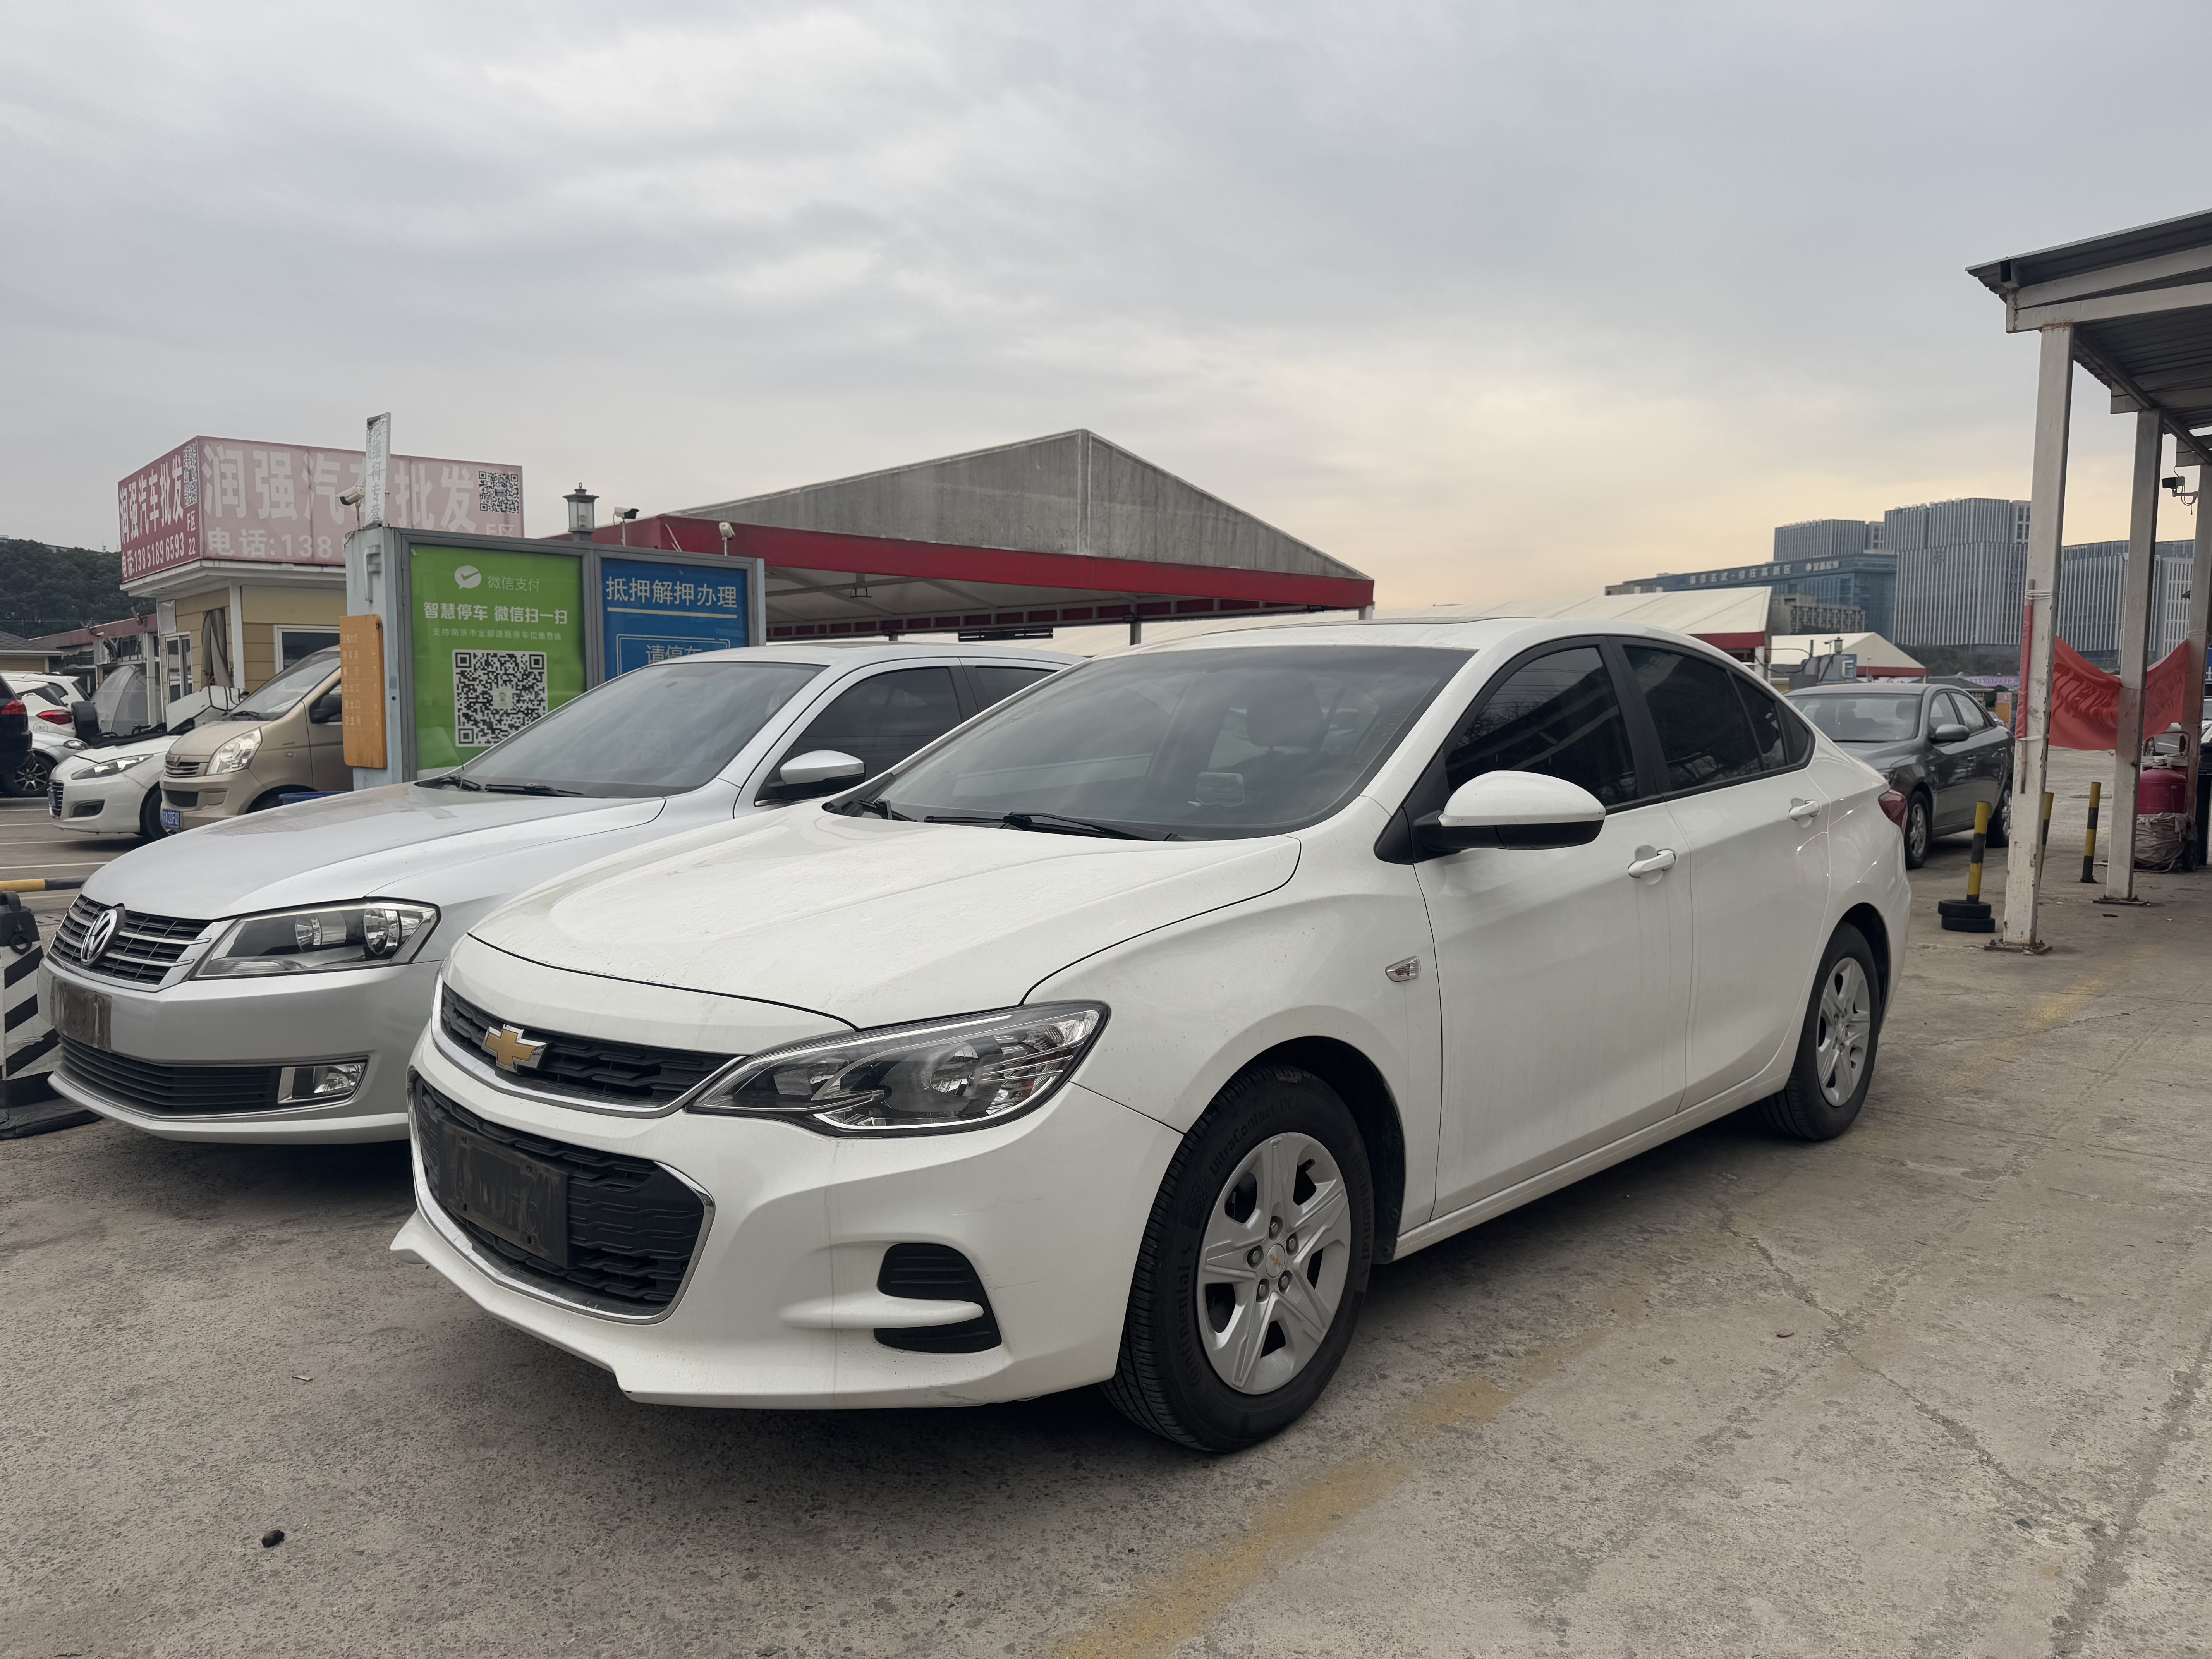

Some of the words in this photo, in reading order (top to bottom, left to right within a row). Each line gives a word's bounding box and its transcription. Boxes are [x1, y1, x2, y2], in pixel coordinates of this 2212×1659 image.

[119, 454, 184, 544] 润强汽车批发
[187, 510, 196, 531] F区
[189, 537, 196, 556] 22
[364, 544, 381, 602] F
[488, 575, 541, 592] 微信支付
[606, 576, 737, 608] 抵押解押办理
[424, 601, 489, 620] 智慧停车
[494, 605, 568, 625] 微信扫一扫
[1842, 659, 1854, 678] E
[1209, 1102, 1276, 1175] UltraContact
[1177, 1265, 1202, 1388] Continental
